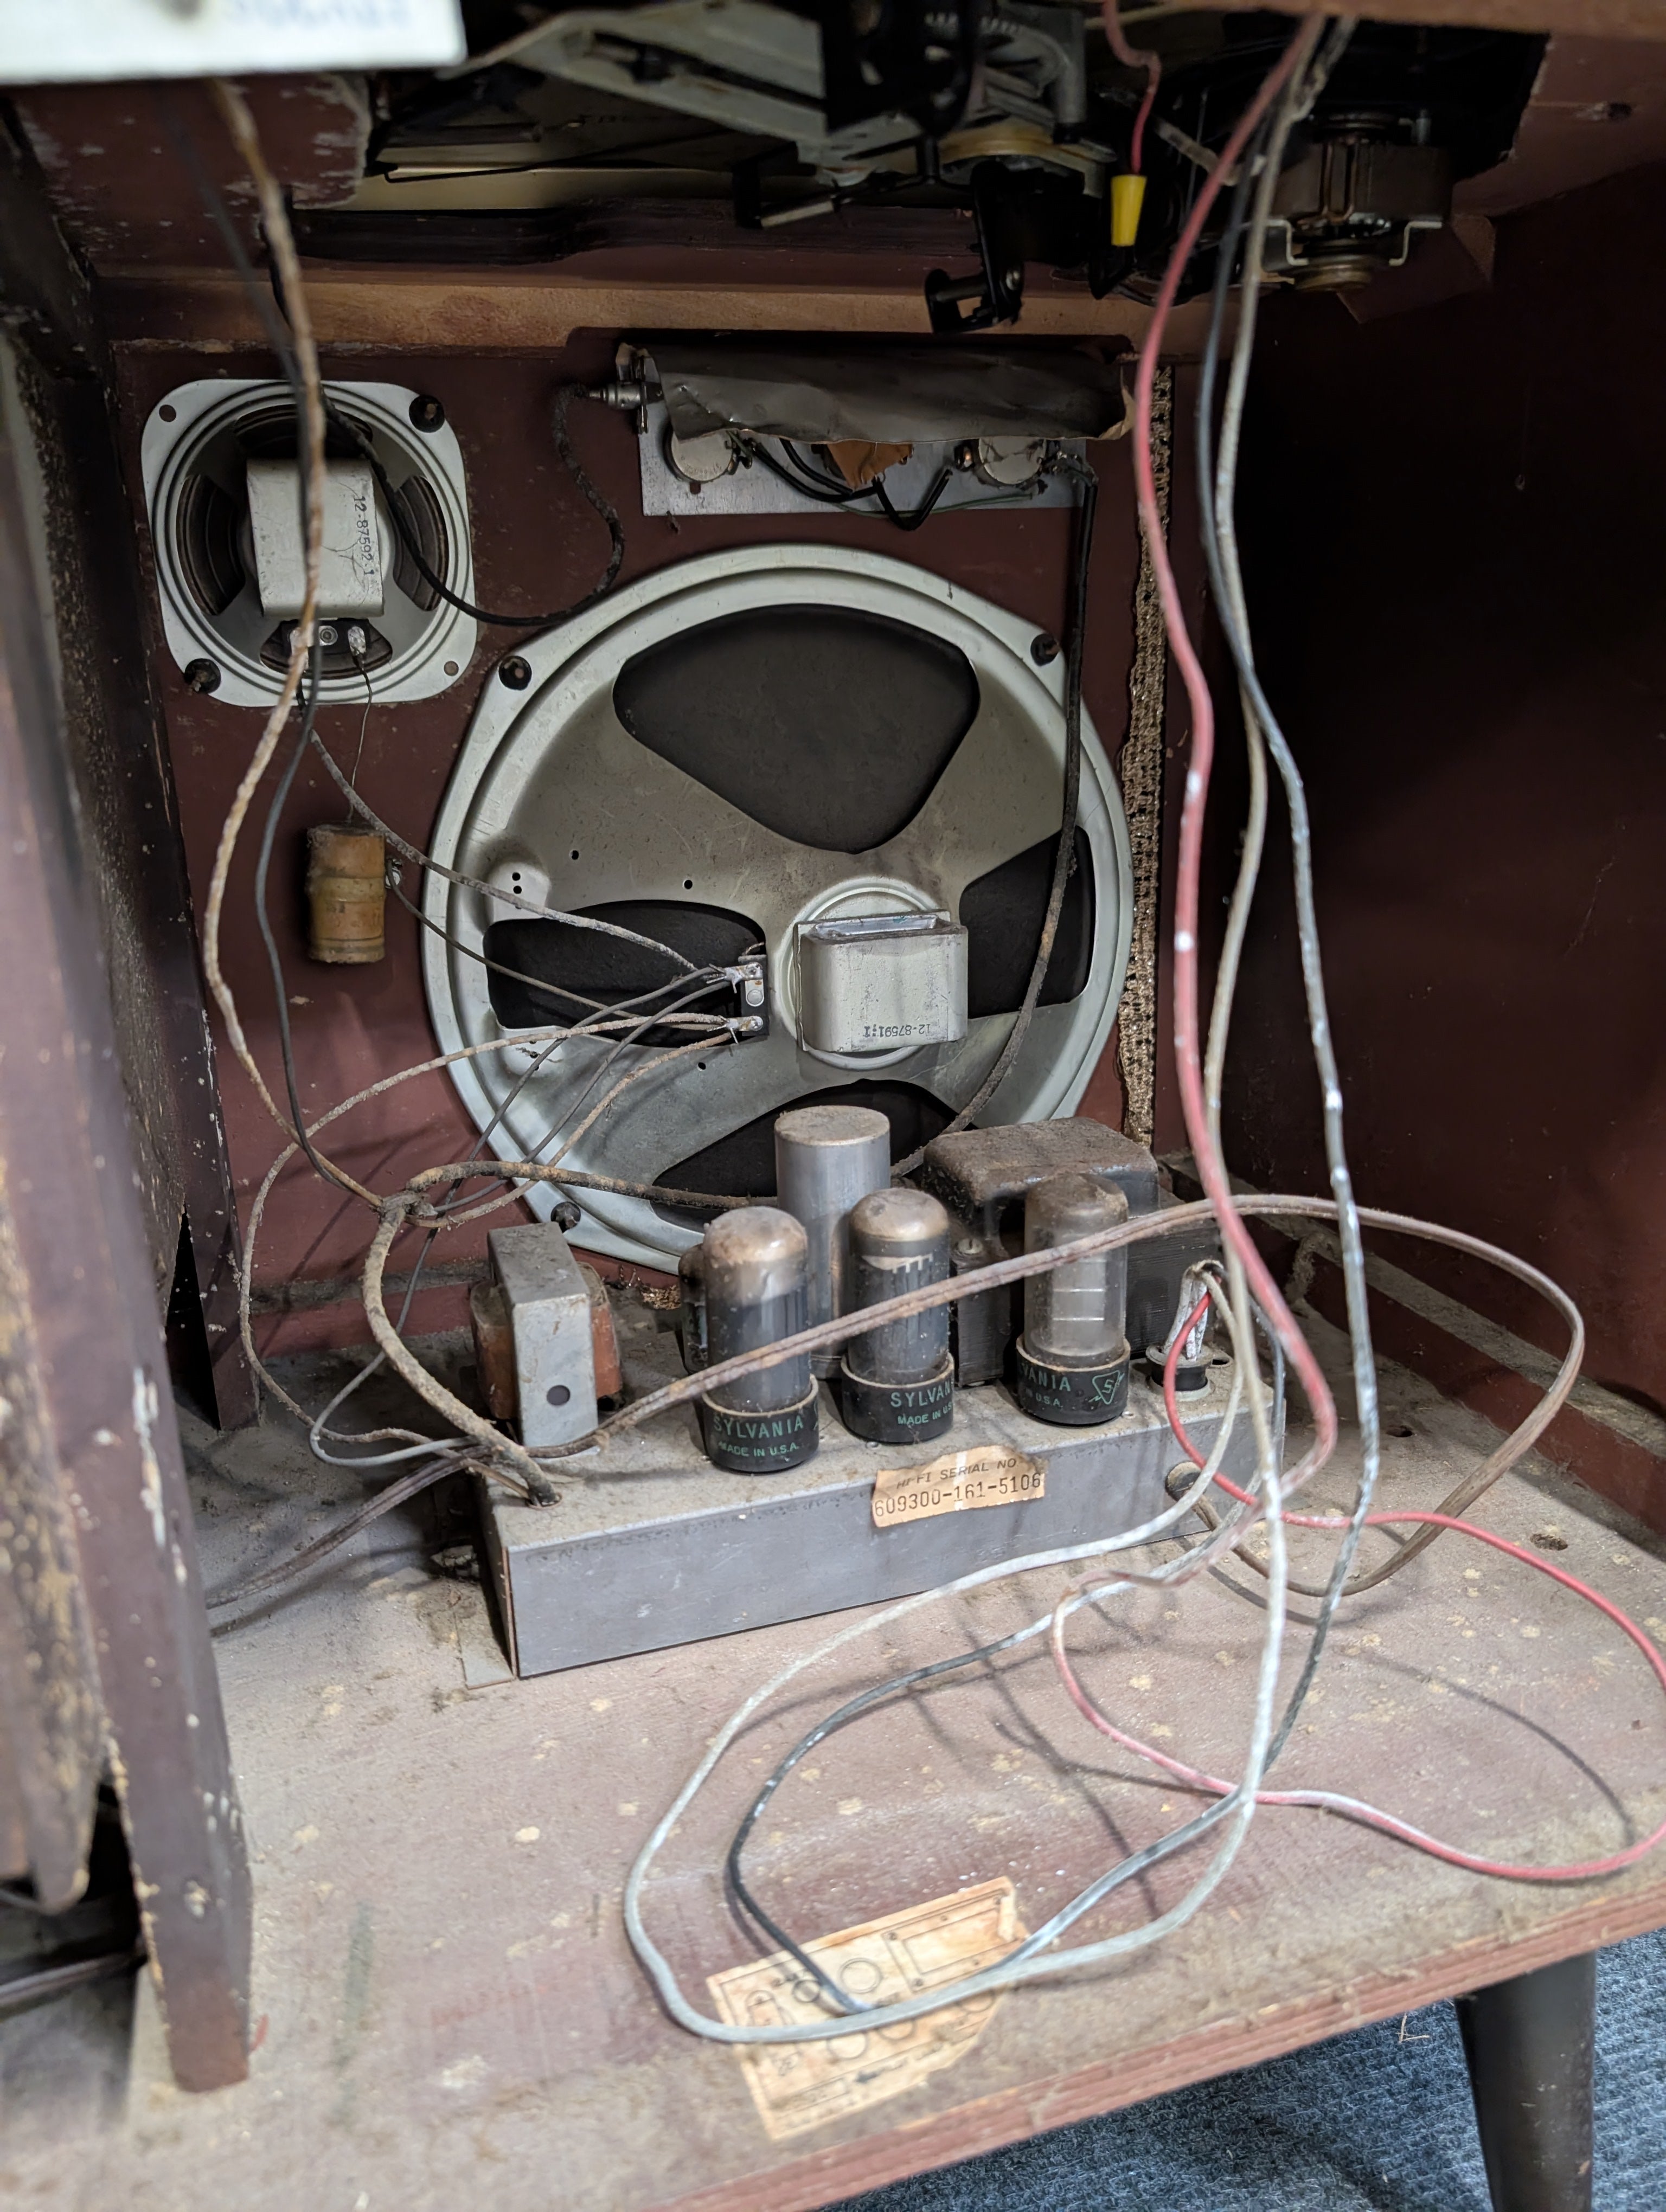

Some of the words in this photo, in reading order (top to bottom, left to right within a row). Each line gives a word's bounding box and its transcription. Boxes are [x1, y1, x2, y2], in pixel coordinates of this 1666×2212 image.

[714, 1415, 804, 1438] SYLVANIA
[898, 1413, 929, 1425] MADE
[932, 1410, 941, 1420] IN
[718, 1441, 749, 1457] MADE
[753, 1448, 765, 1457] IN
[770, 1442, 799, 1456] U.S.A.
[896, 1472, 932, 1489] HI-FI
[939, 1463, 989, 1480] SERIAL
[875, 1472, 1041, 1517] 609300-161-5106
